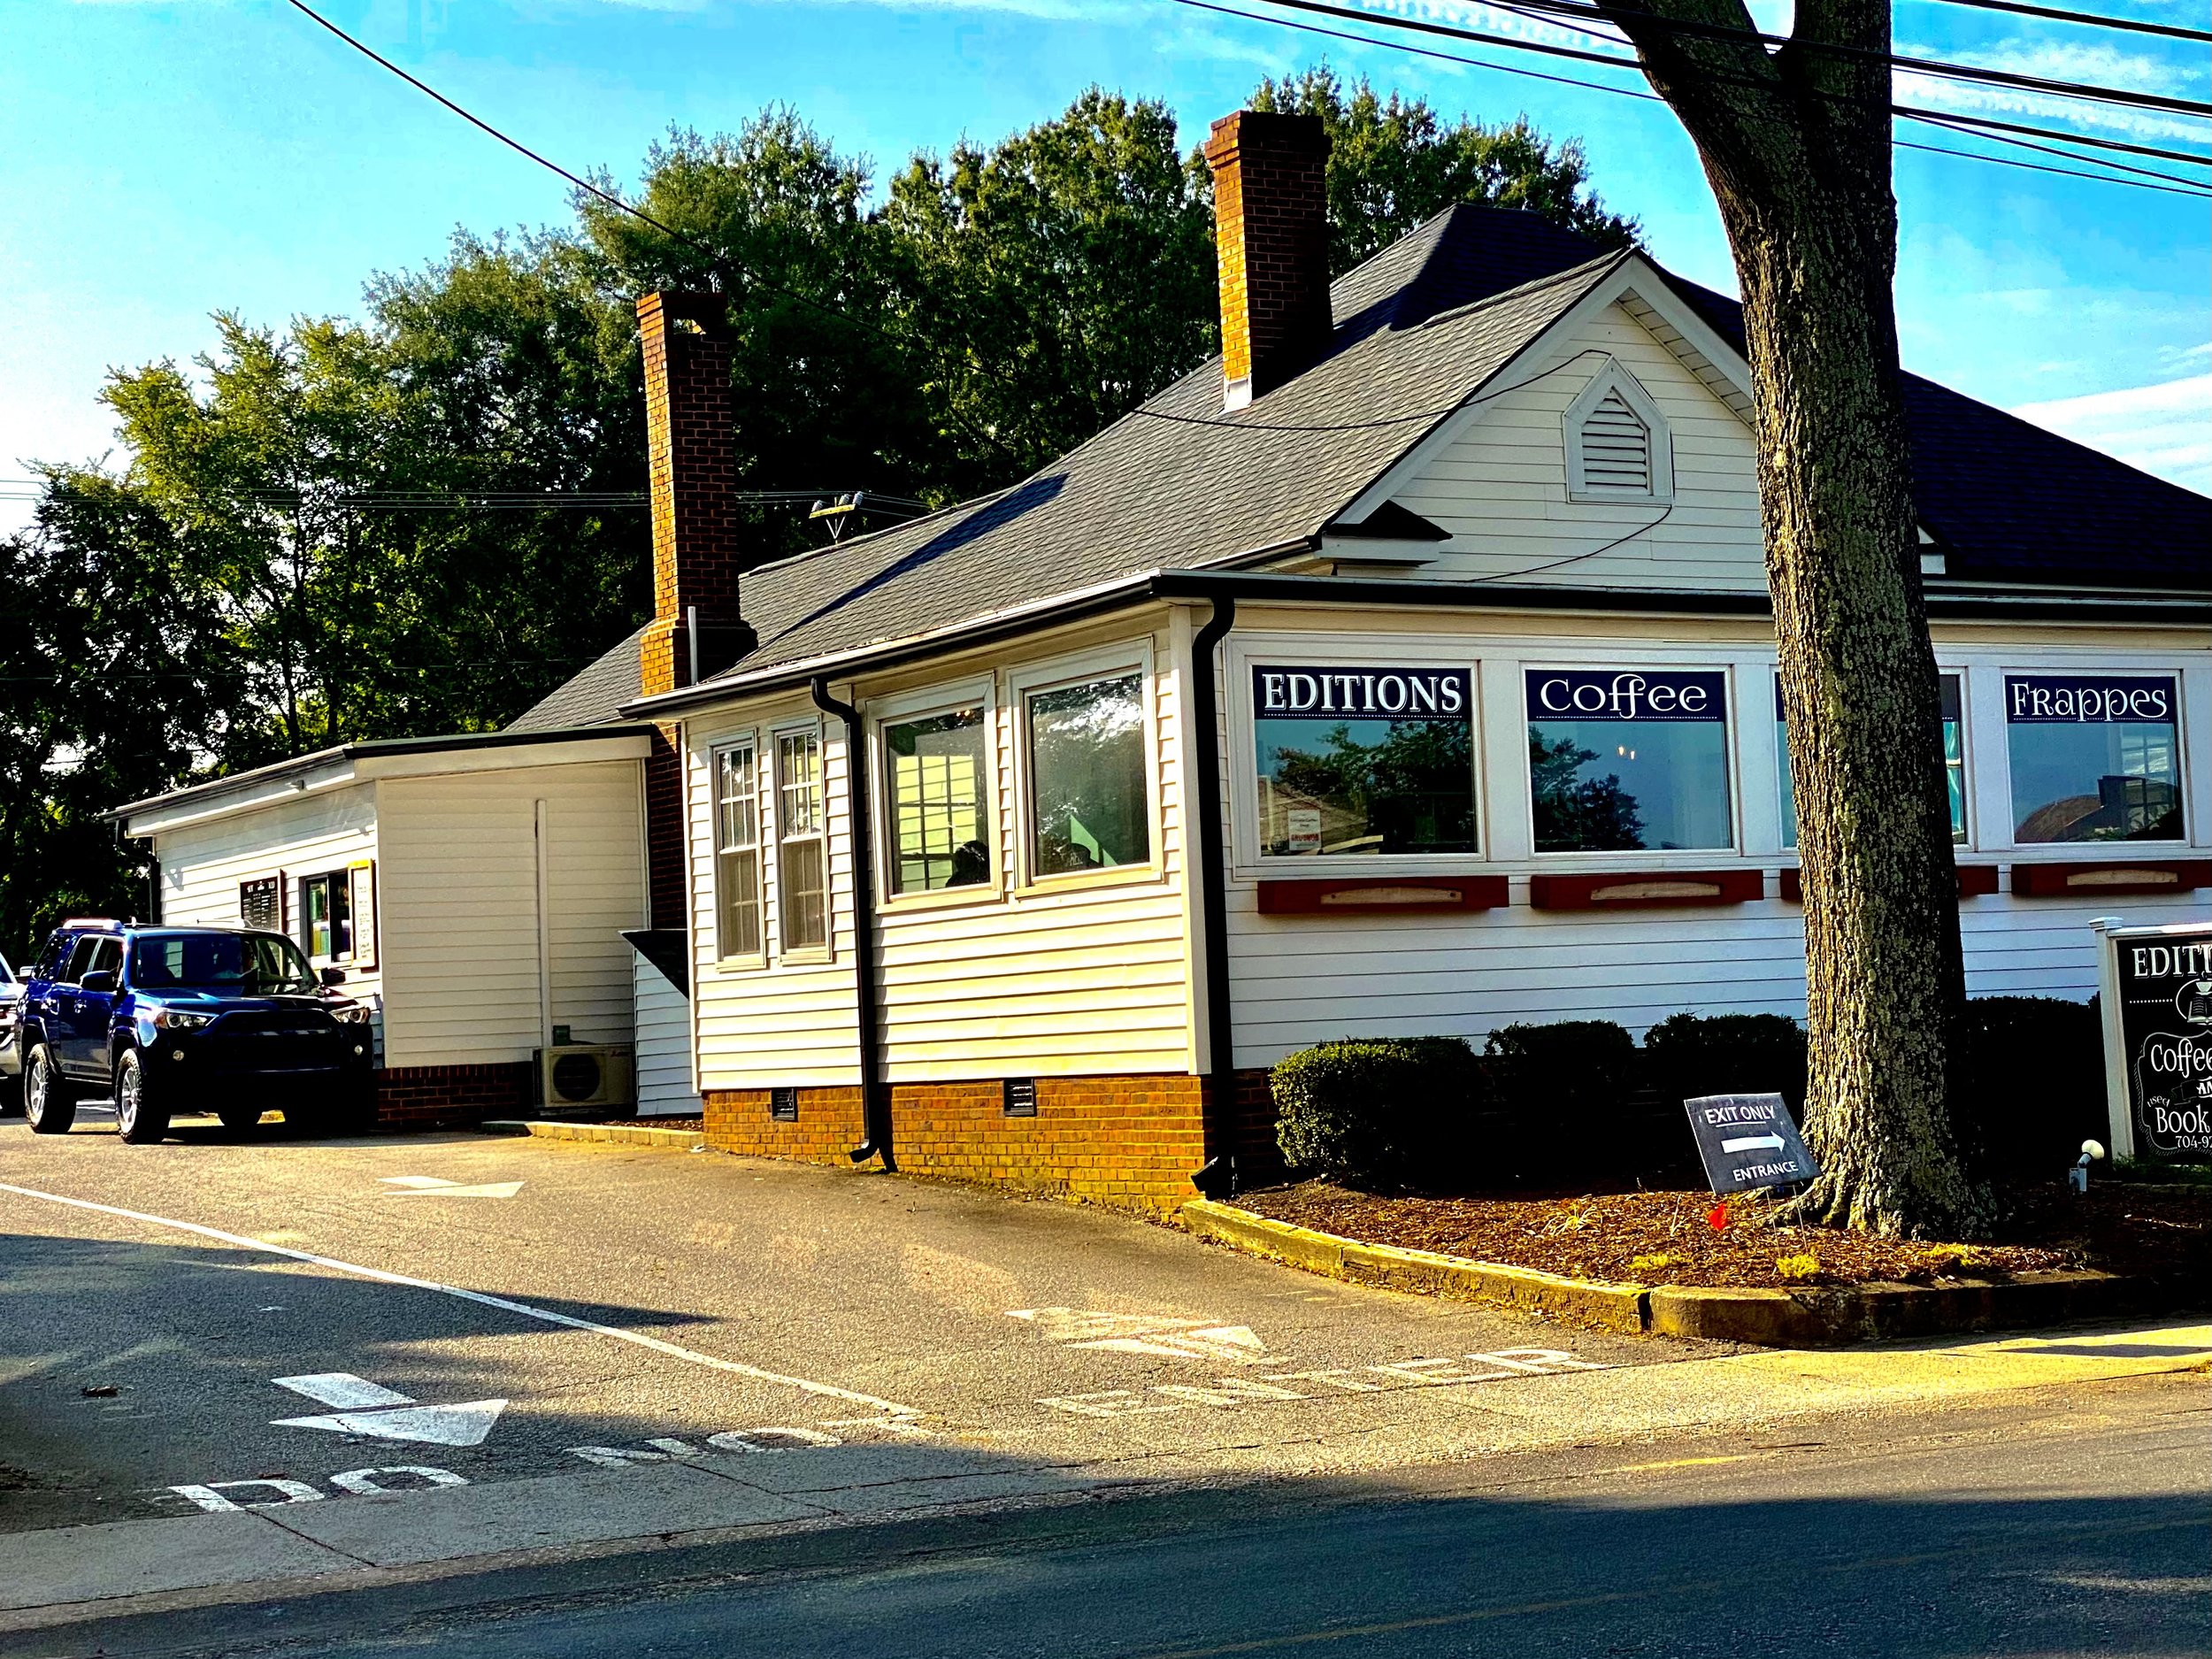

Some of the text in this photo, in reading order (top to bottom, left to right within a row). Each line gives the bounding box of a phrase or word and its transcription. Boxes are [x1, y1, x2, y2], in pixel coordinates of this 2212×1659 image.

[1263, 673, 1463, 712] EDITIONS
[1540, 673, 1708, 718] Coffee
[2011, 681, 2168, 722] Frappes
[1704, 1104, 1776, 1125] EXIT ONLY
[2147, 1095, 2170, 1108] used
[2154, 1103, 2211, 1133] Book
[1732, 1161, 1799, 1182] ENTRANCE
[167, 1465, 471, 1512] DO
